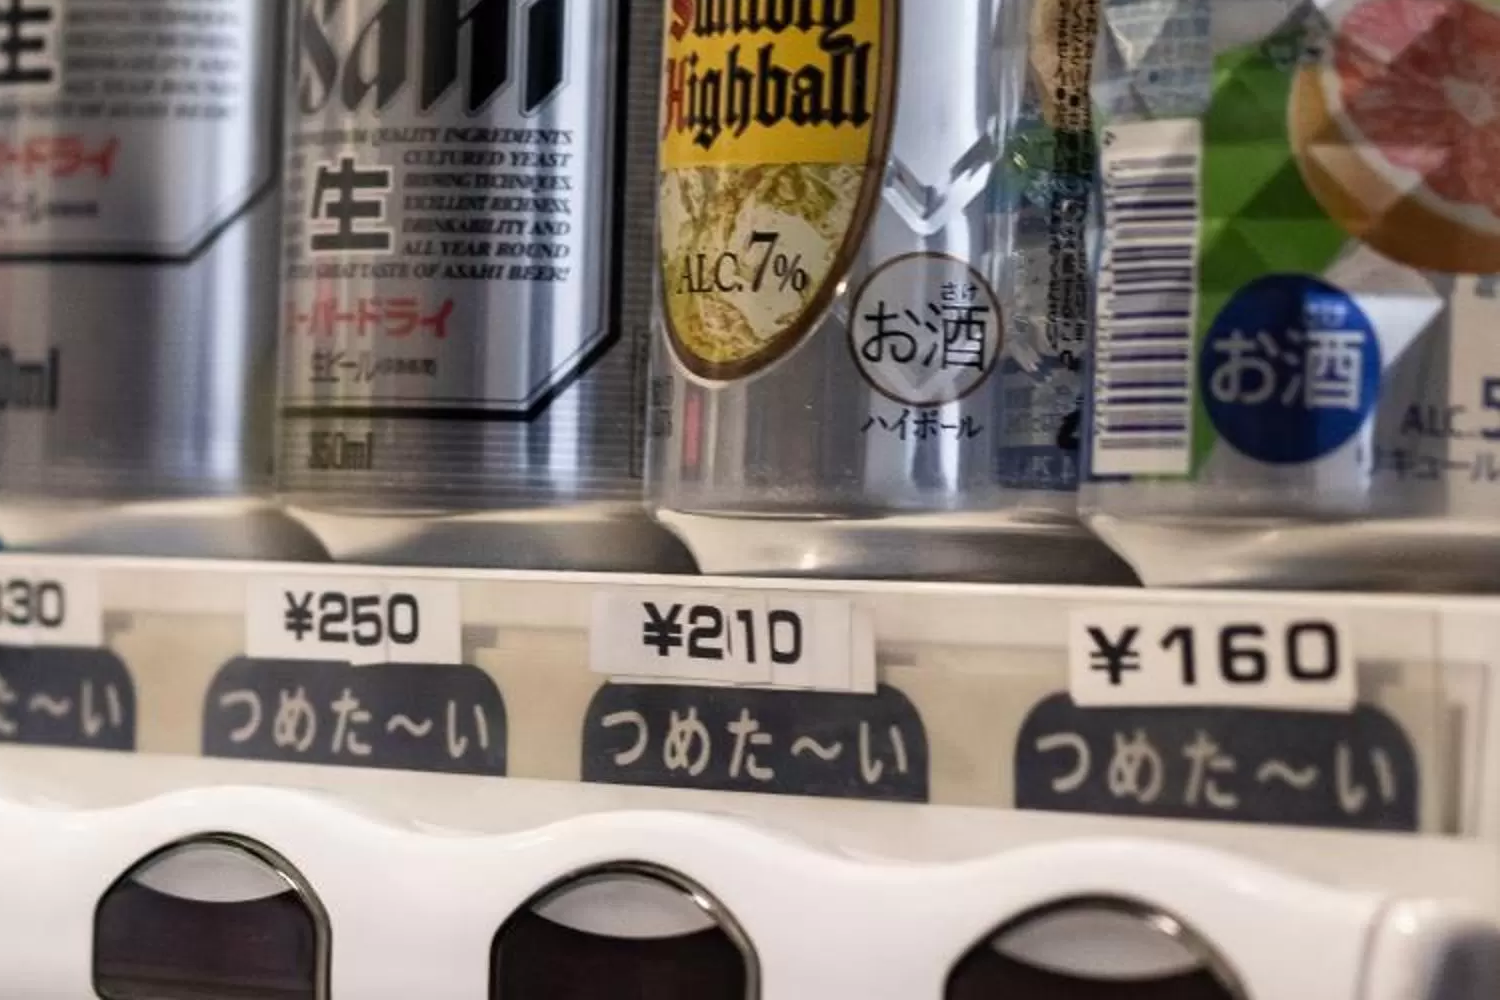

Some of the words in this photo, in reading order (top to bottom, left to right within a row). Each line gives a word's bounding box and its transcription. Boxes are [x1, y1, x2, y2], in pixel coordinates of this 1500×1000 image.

[664, 42, 873, 150] Highball
[508, 151, 573, 168] YEAST
[311, 157, 390, 250] 生
[529, 220, 572, 236] AND
[495, 242, 571, 258] ROUND
[862, 301, 990, 371] お酒
[1211, 328, 1365, 411] お酒
[861, 408, 983, 440] ハイボール
[283, 591, 420, 646] ¥250
[642, 600, 804, 666] ¥210
[1087, 619, 1341, 688] ¥160
[217, 689, 490, 759] つめた〜い
[599, 709, 910, 784] つめた〜い
[1034, 730, 1398, 816] つめた〜い
